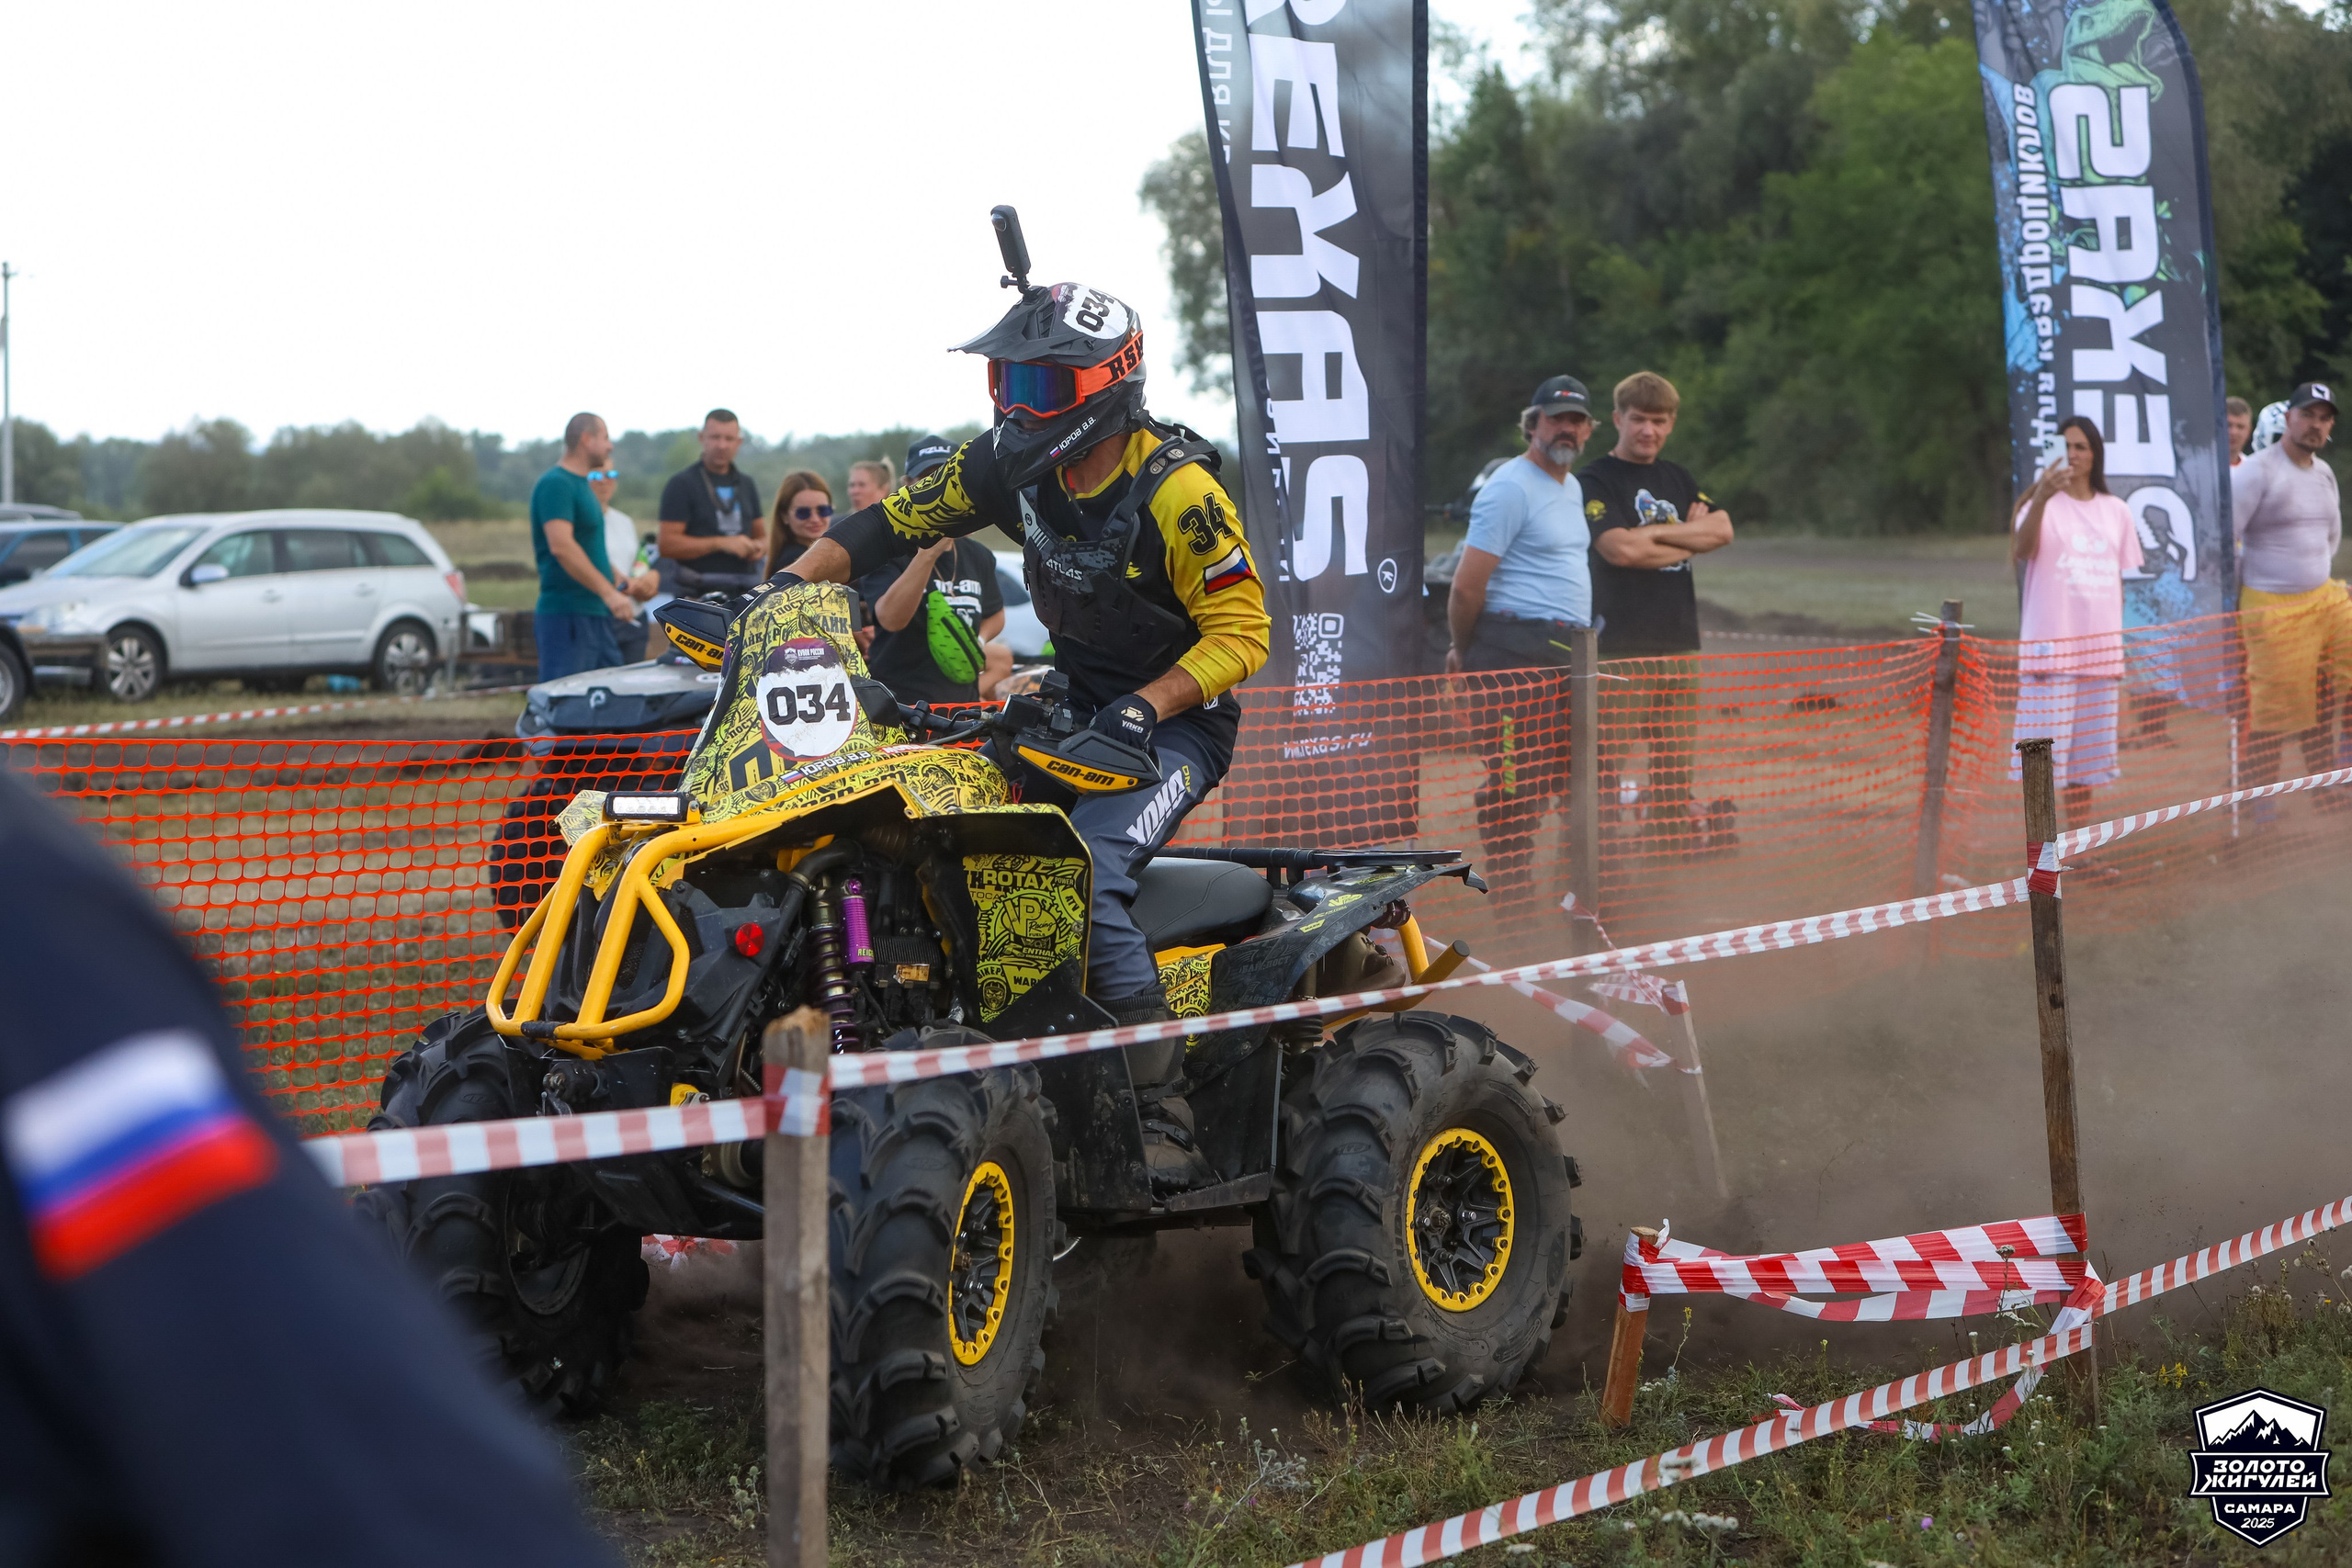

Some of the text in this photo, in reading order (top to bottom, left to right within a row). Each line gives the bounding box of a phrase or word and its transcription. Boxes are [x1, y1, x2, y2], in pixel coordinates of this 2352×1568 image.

[1244, 0, 1370, 581] EXAS
[1075, 288, 1115, 333] 034
[1058, 427, 1082, 450] ЮРОВ
[1177, 492, 1236, 556] 34
[1046, 558, 1083, 581] ATLAS
[766, 682, 852, 726] 034
[1046, 759, 1115, 786] can-am
[981, 869, 1074, 892] ROTAX POWER
[1013, 976, 1041, 988] WAR
